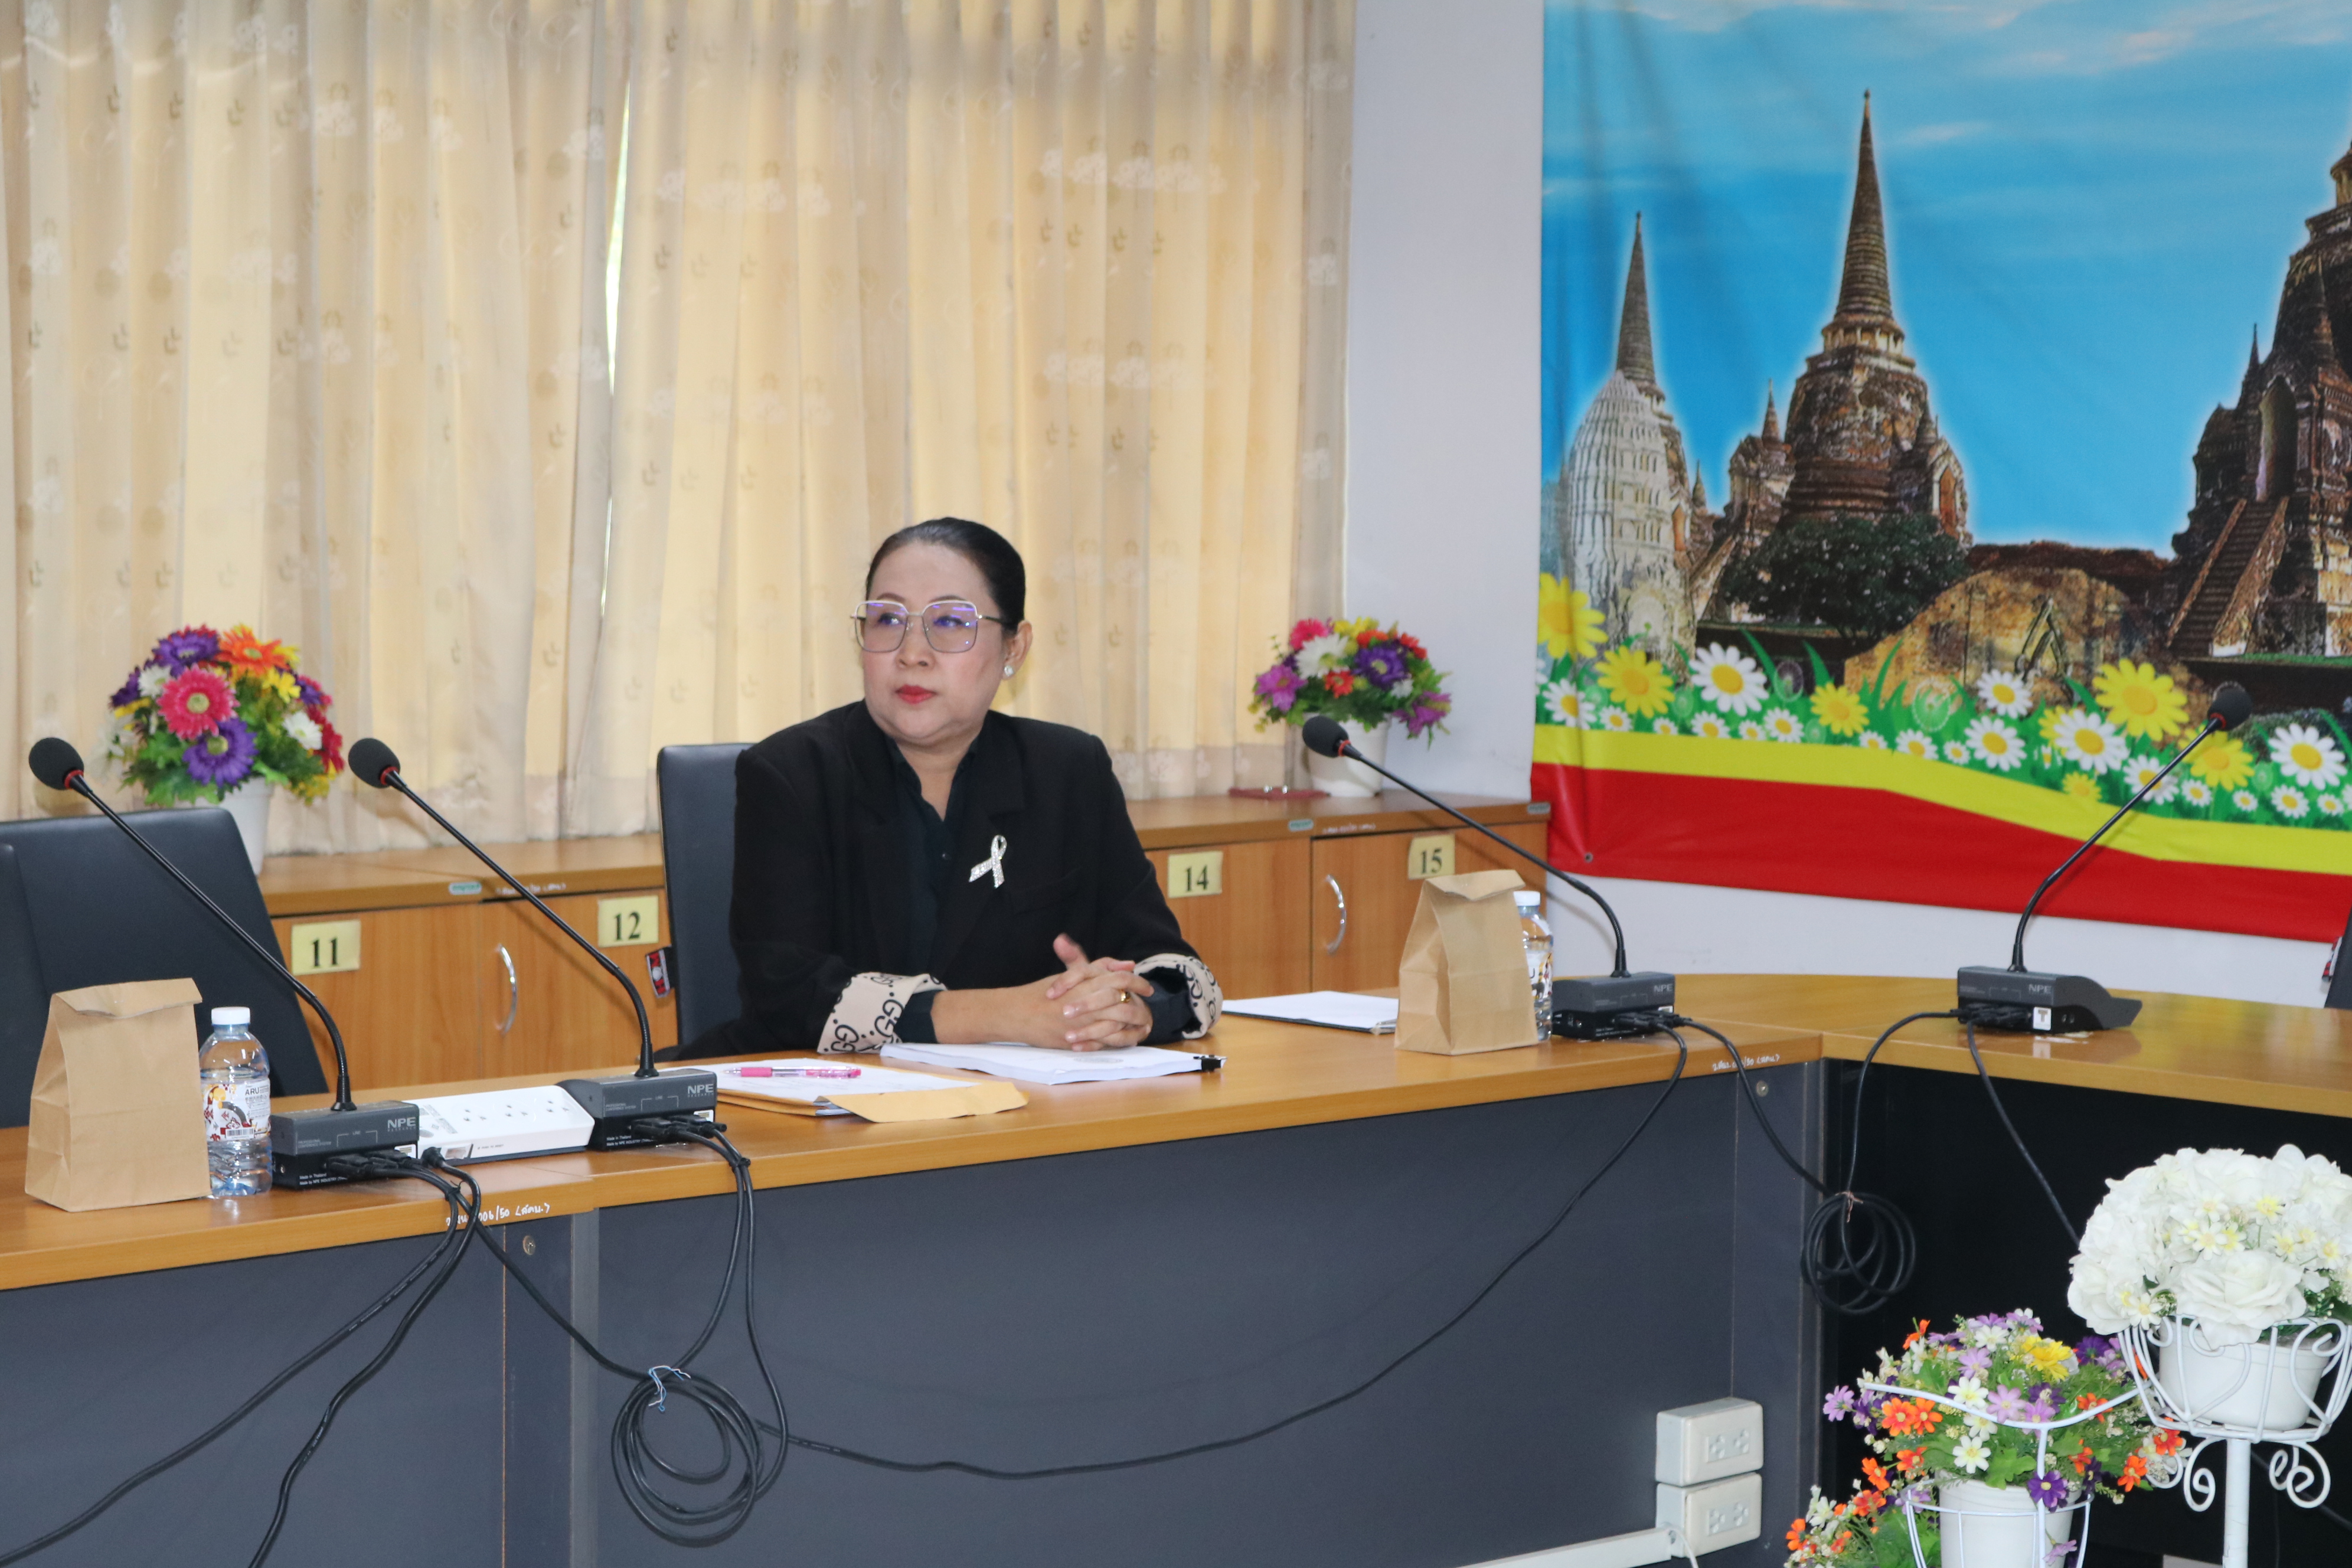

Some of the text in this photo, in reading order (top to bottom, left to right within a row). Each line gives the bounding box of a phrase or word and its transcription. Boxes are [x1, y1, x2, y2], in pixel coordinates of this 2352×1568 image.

[1421, 848, 1442, 873] 15
[1185, 866, 1209, 893] 14
[614, 912, 641, 940] 12
[312, 938, 338, 967] 11
[1654, 984, 1672, 992] NPE
[2028, 984, 2052, 994] NPE
[245, 1087, 259, 1096] ARU
[688, 1084, 714, 1094] NPE
[388, 1116, 416, 1128] NPE
